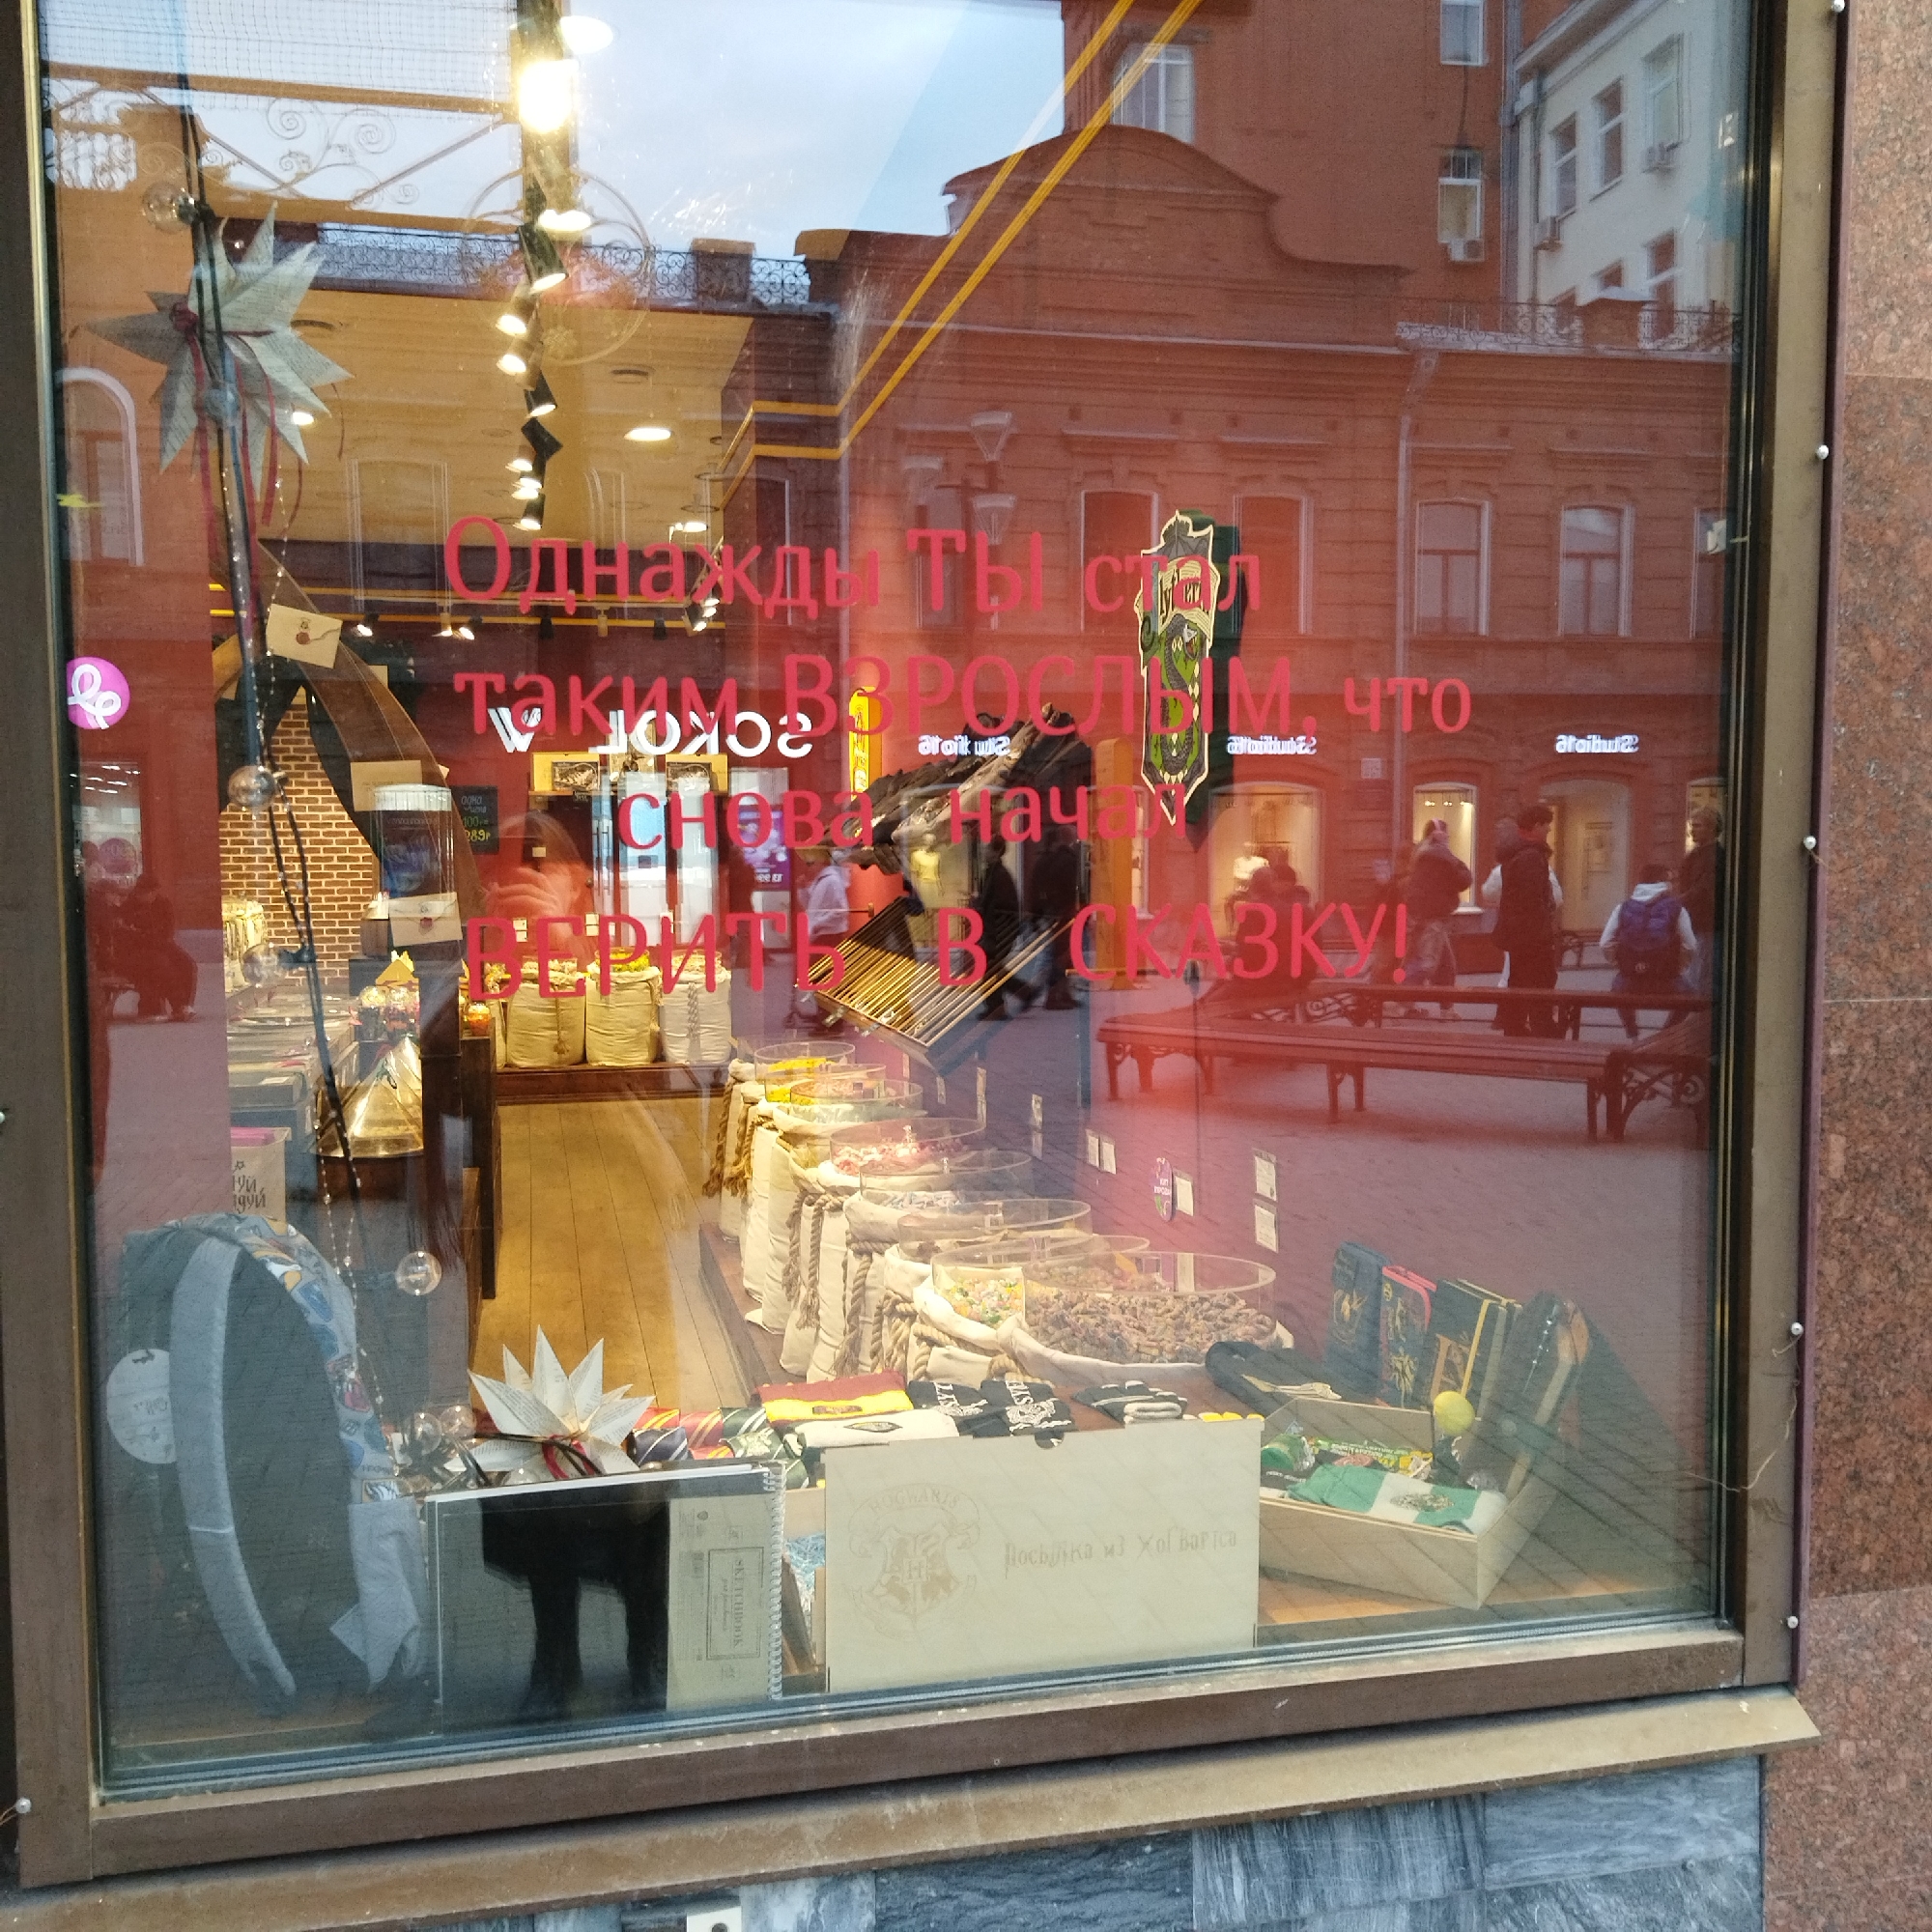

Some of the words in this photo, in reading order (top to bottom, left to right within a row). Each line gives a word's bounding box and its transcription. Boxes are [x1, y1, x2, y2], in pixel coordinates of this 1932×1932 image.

[444, 516, 879, 620] Однажды
[906, 529, 1043, 612] ТЫ
[1084, 554, 1261, 611] стал
[454, 671, 737, 737] таким
[783, 654, 1317, 741] ВЗРОСЛЫМ,
[1344, 676, 1472, 733] что
[618, 789, 874, 851] снова
[950, 781, 1187, 844] начал
[468, 911, 845, 1001] ВЕРИТЬ
[938, 907, 986, 986] В
[1069, 902, 1407, 983] СКАЗКУ!
